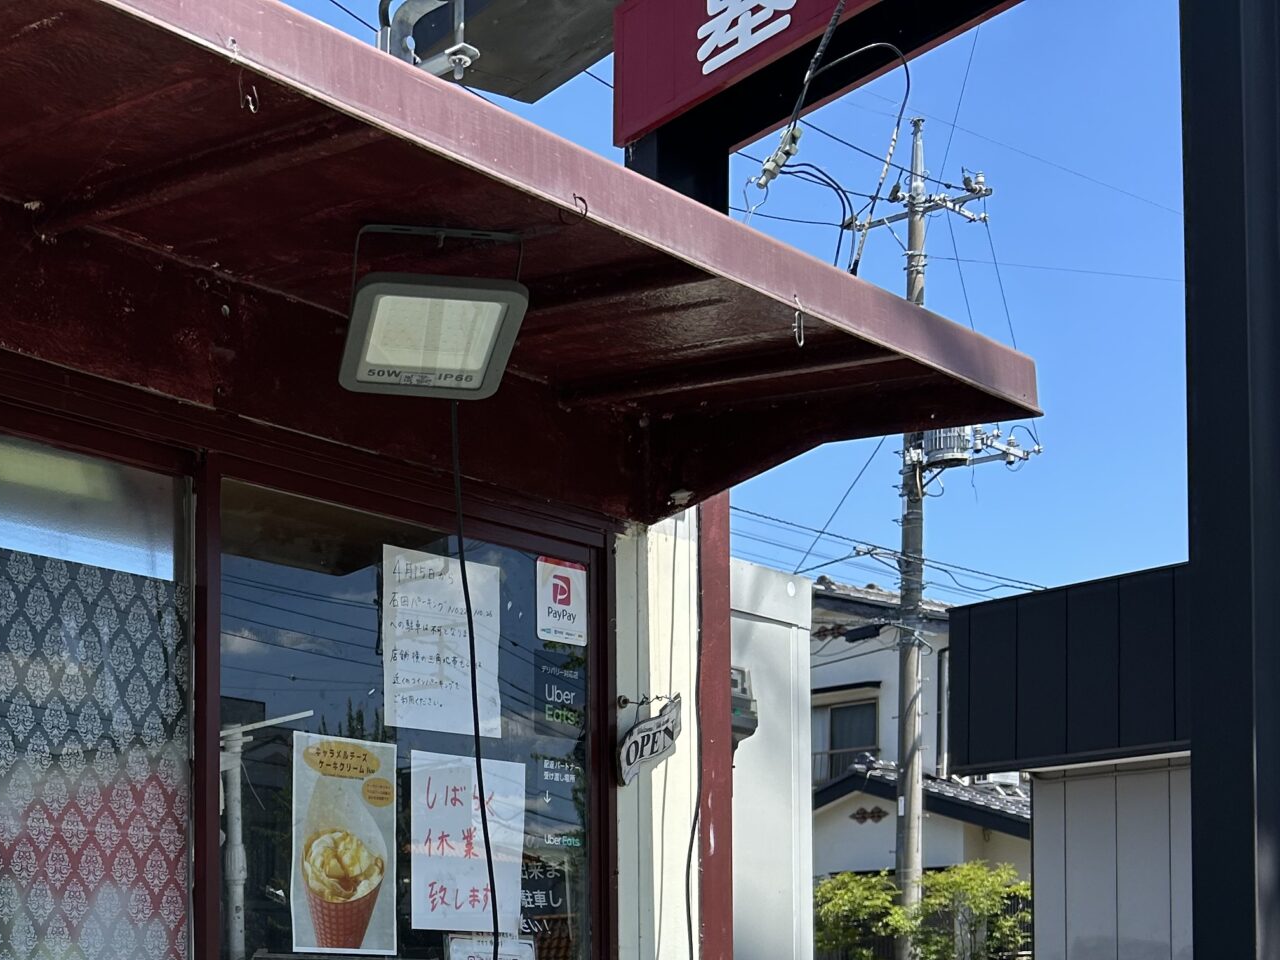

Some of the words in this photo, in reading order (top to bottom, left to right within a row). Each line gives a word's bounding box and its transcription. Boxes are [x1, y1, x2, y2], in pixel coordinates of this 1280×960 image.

[367, 368, 402, 379] 50W
[437, 374, 474, 383] IP66
[547, 606, 577, 623] PayPay
[545, 683, 576, 705] Uber
[545, 704, 577, 725] Eats
[626, 720, 676, 767] OPEN
[318, 760, 365, 774] ケーキクリーム
[424, 828, 479, 860] 休業
[544, 834, 561, 845] Uber
[562, 836, 581, 847] Eats
[428, 881, 492, 913] 致します
